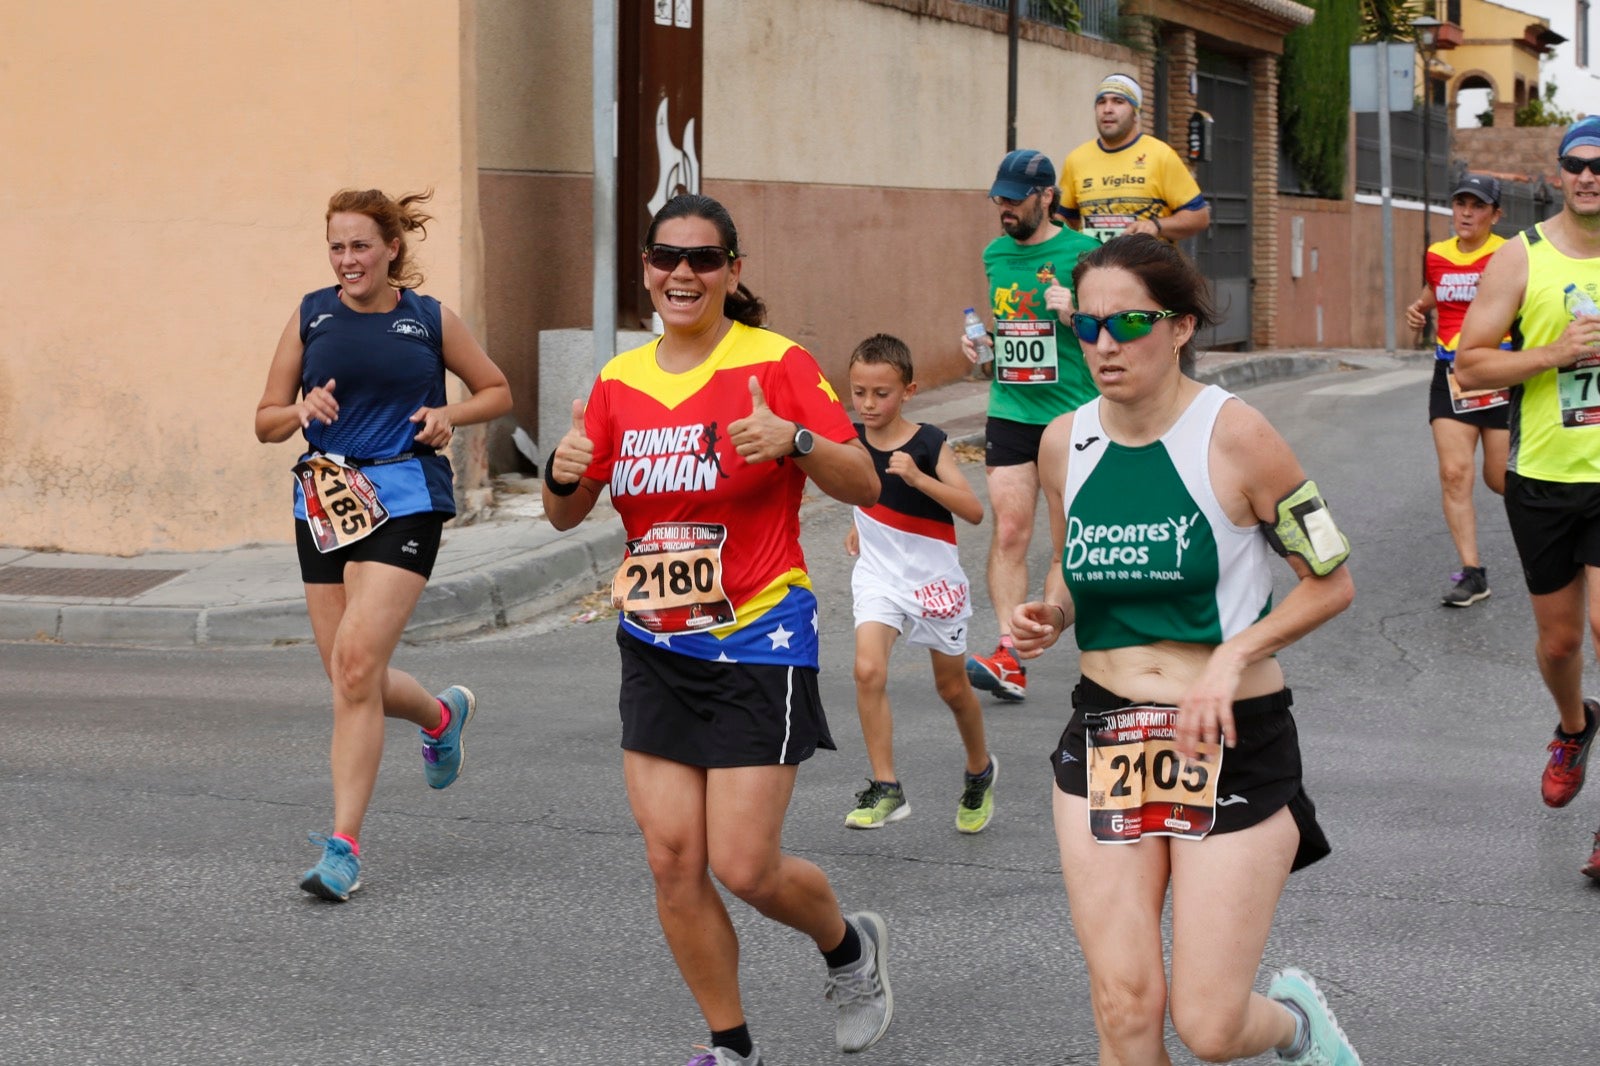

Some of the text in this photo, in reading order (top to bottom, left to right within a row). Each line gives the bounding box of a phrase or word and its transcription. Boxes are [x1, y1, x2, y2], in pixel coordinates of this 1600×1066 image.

[1102, 173, 1146, 188] Vigilsa
[1436, 285, 1478, 302] WOMA
[1004, 340, 1045, 363] 900
[1574, 372, 1600, 402] 7
[620, 424, 705, 458] RUNNER
[610, 452, 722, 498] WOMAN
[652, 526, 679, 541] PREMIO
[680, 526, 692, 540] DE
[1065, 516, 1171, 548] DEPORTES
[1066, 539, 1150, 570] DELFOS
[626, 557, 715, 601] 2180
[1117, 713, 1135, 729] GRAN
[1135, 711, 1167, 727] PREMIO
[1148, 727, 1177, 738] CRUZCA
[1110, 749, 1209, 797] 2105
